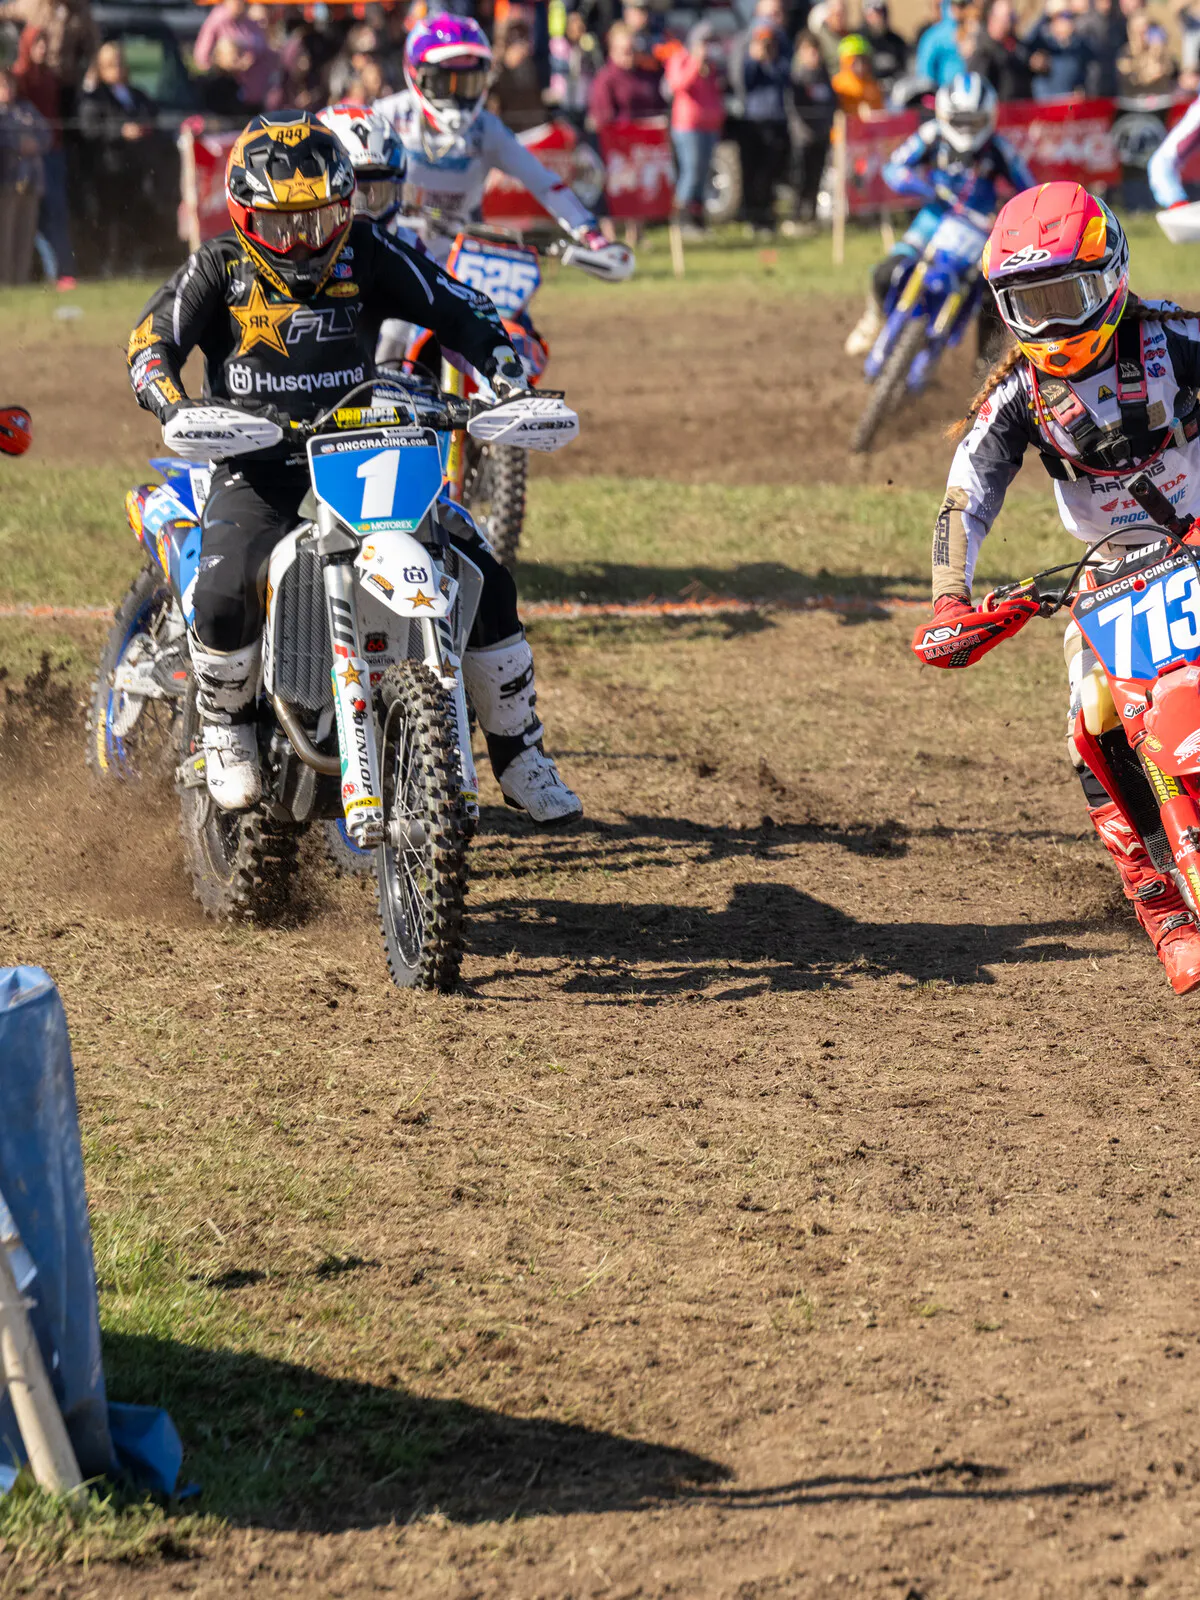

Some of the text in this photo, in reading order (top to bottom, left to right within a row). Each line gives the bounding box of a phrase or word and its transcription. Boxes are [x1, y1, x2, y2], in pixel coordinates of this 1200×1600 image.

[455, 253, 537, 308] 525
[256, 365, 364, 393] Husqvarna
[173, 425, 236, 440] ACERBIS
[517, 420, 575, 432] ACERBIS
[336, 437, 429, 450] GNCCRACING.COM
[356, 449, 400, 519] 1
[1121, 473, 1187, 509] HDA
[1111, 487, 1186, 526] PROGIVE
[371, 520, 413, 532] MOTOREX
[367, 639, 385, 652] 66
[922, 623, 963, 645] ASV
[923, 634, 981, 660] MAKSON
[354, 715, 374, 796] DUNLOP
